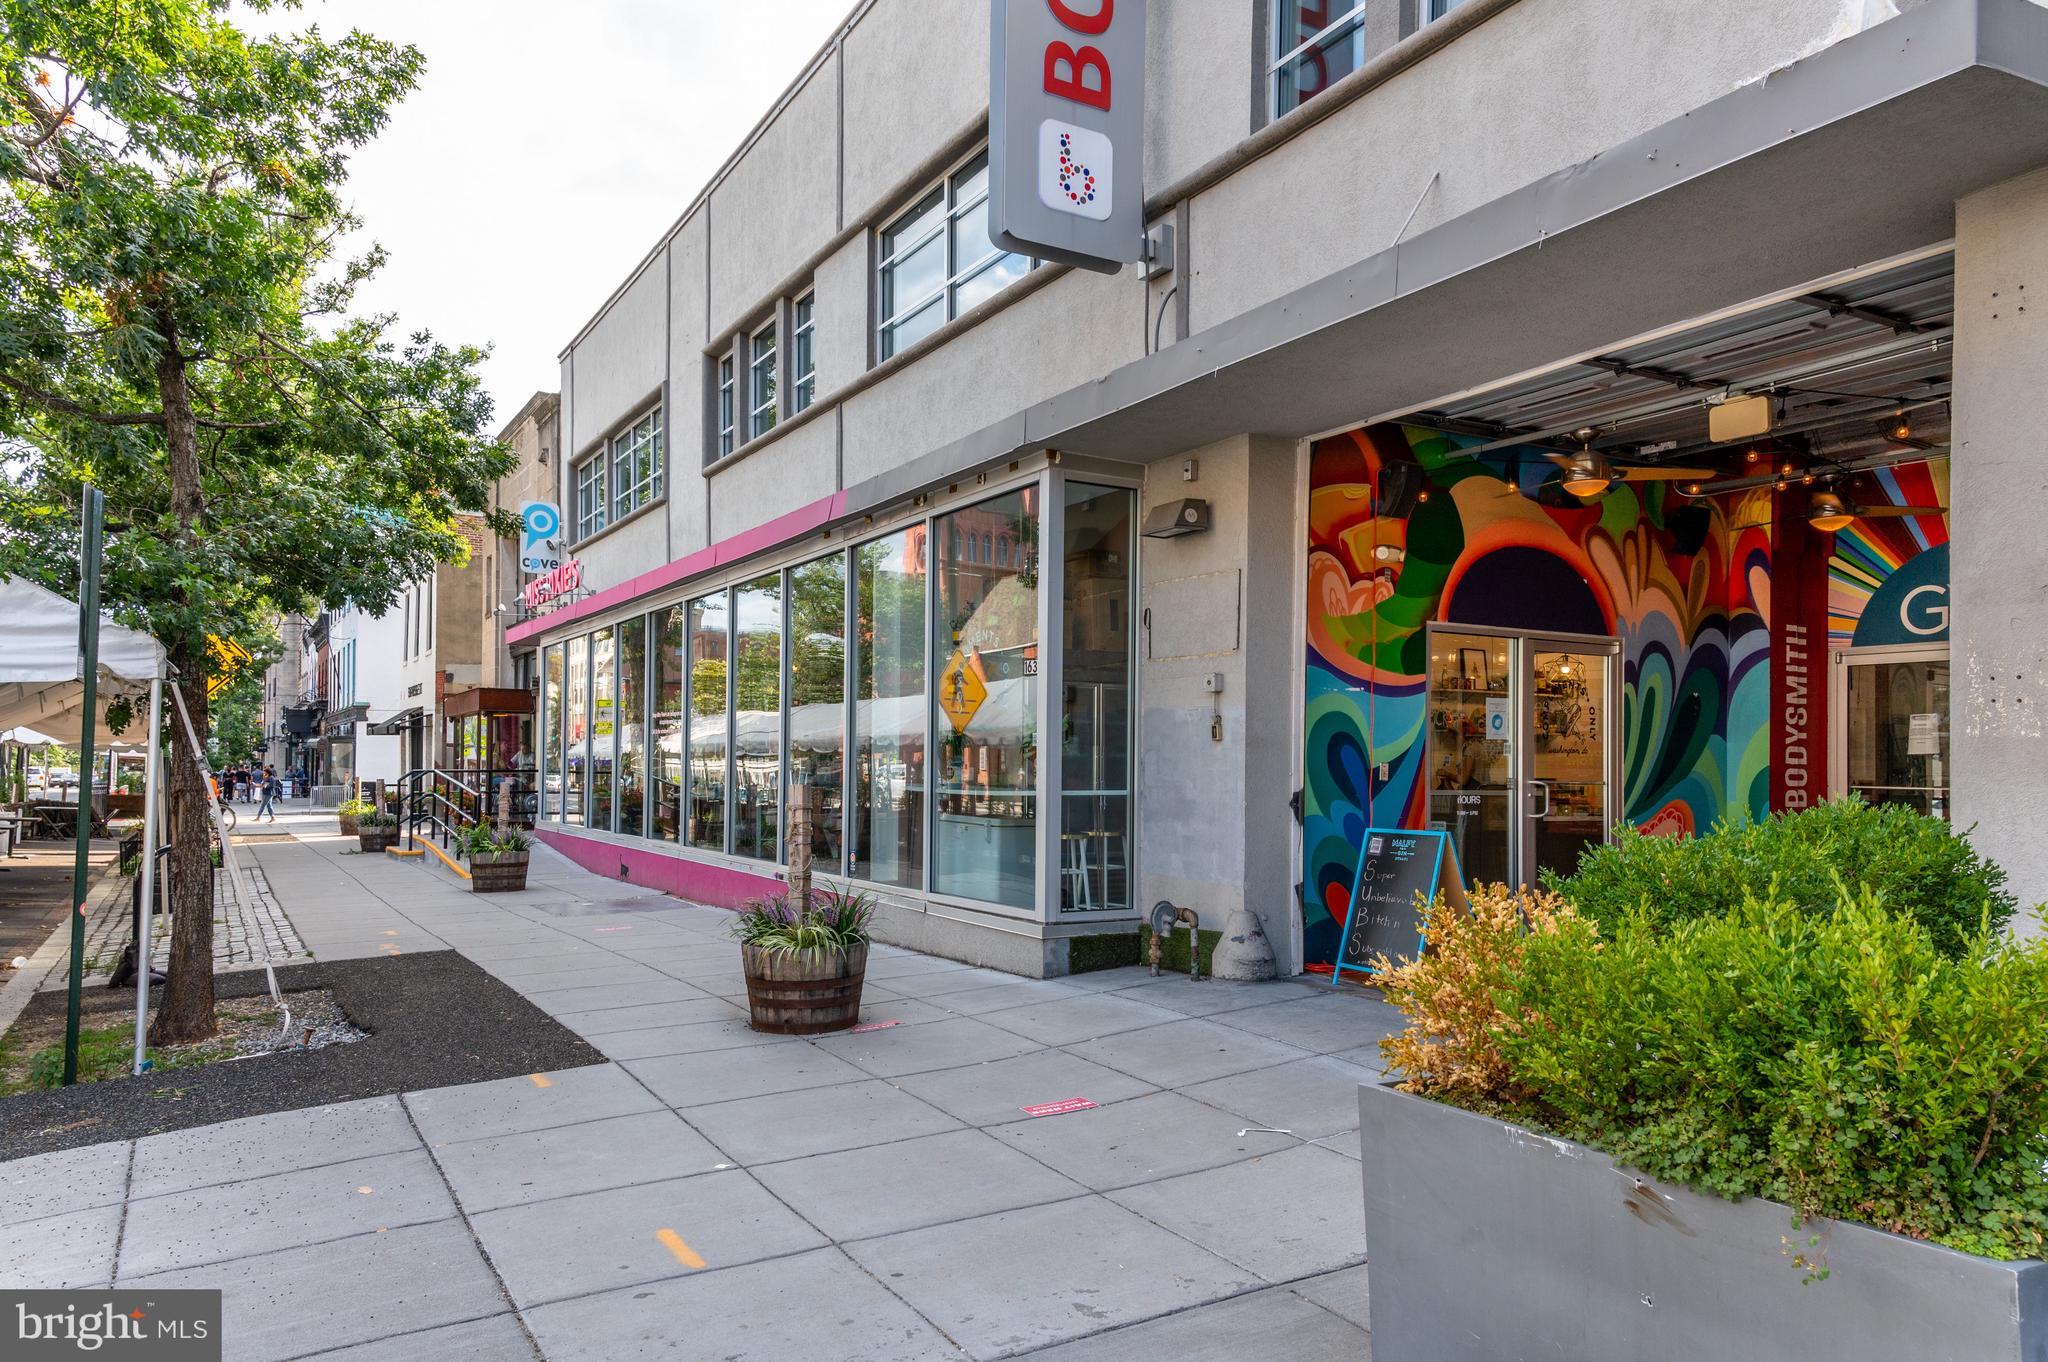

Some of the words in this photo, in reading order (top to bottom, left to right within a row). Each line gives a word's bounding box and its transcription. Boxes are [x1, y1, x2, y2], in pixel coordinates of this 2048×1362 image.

[522, 557, 559, 572] cove
[1900, 584, 1950, 636] G
[1588, 706, 1597, 741] ONLY
[1785, 624, 1808, 808] BODYSMITH
[1363, 859, 1396, 883] Super
